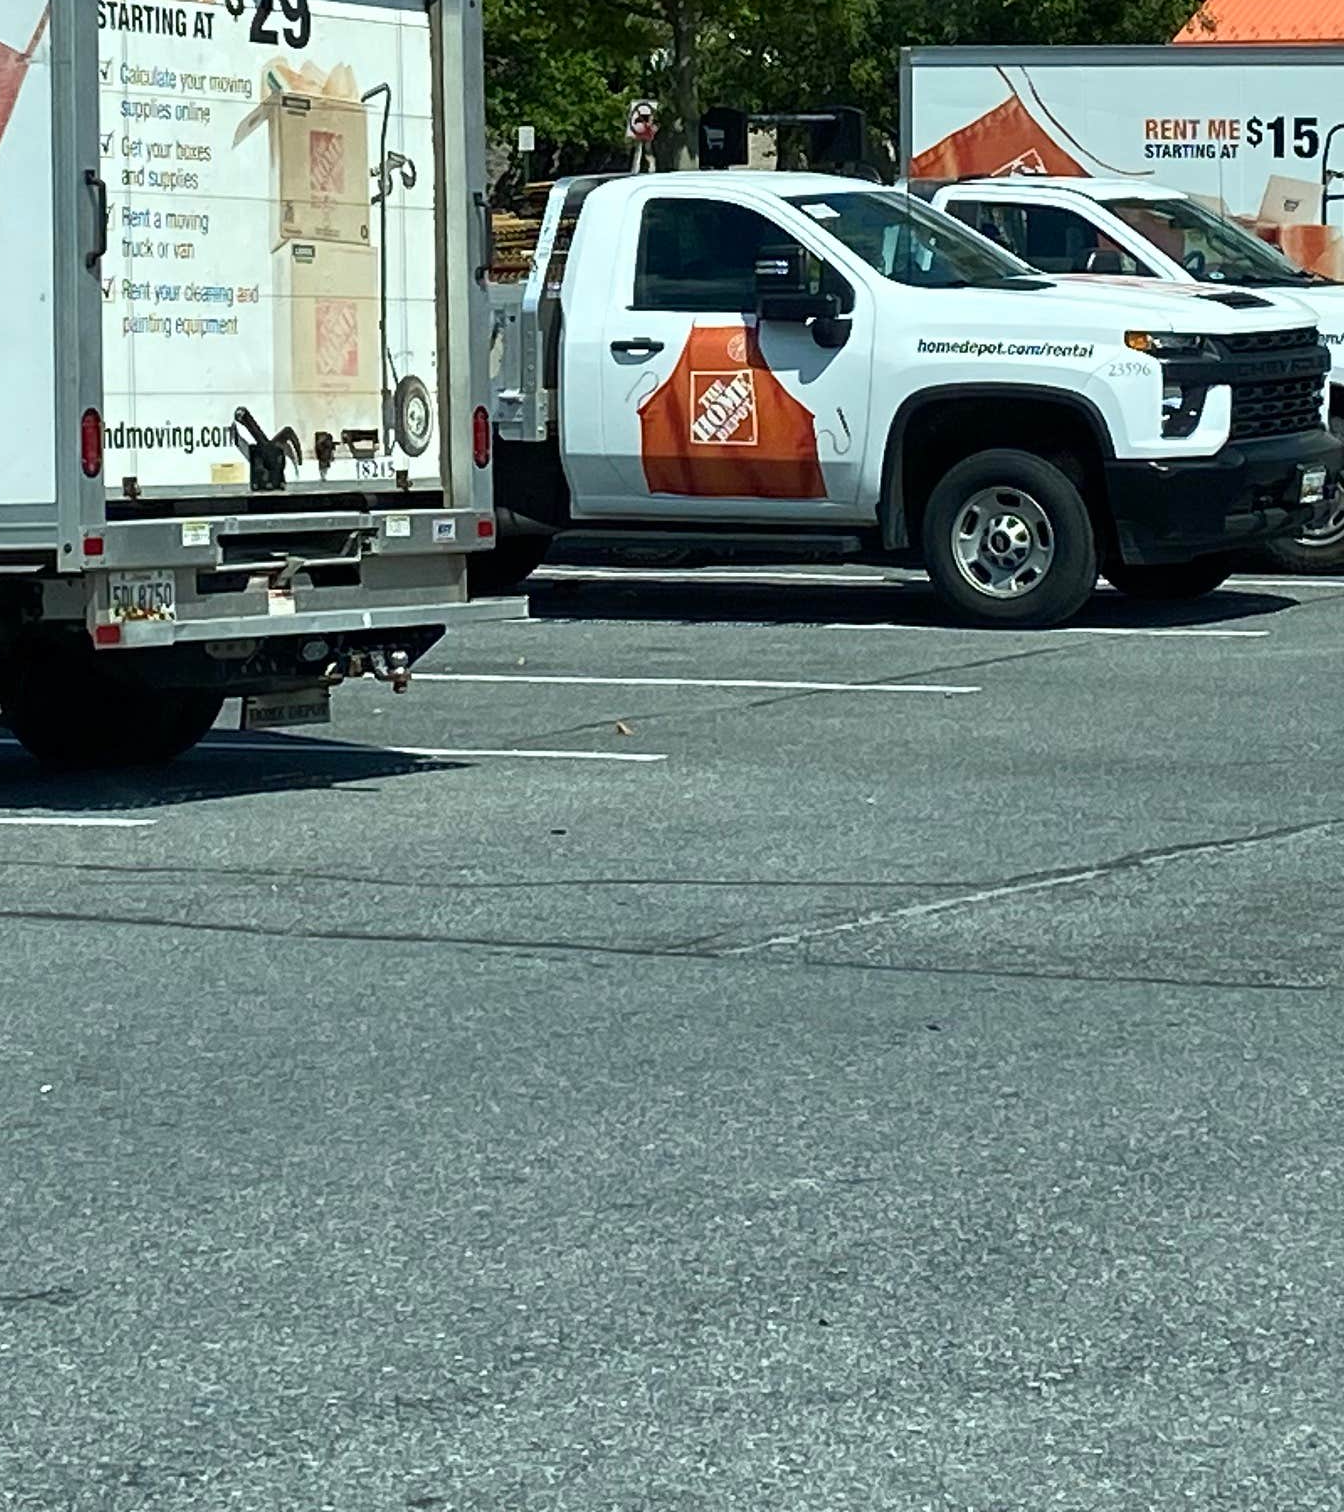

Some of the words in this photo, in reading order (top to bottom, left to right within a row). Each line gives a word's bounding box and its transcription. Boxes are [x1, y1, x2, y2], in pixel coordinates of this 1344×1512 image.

[97, 0, 187, 37] STARTING
[193, 11, 215, 39] AT
[120, 62, 177, 89] Calculate
[180, 73, 207, 93] your
[209, 75, 252, 99] moving
[120, 99, 172, 123] supplies
[176, 101, 211, 122] online
[1145, 119, 1200, 139] RENT
[1208, 119, 1240, 139] ME
[1246, 116, 1319, 159] $15
[121, 136, 143, 157] Get
[146, 141, 173, 162] your
[176, 140, 212, 161] boxes
[1144, 144, 1216, 159] STARTING
[1219, 144, 1239, 159] AT
[121, 167, 145, 186] and
[148, 168, 199, 191] supplies
[121, 207, 151, 229] Rent
[154, 213, 162, 229] a
[166, 212, 209, 236] moving
[121, 239, 154, 258] truck
[157, 243, 169, 258] or
[174, 243, 195, 259] van
[121, 278, 151, 301] Rent
[154, 284, 182, 306] your
[184, 282, 234, 307] cleaning
[236, 284, 260, 303] and
[122, 314, 172, 337] painting
[175, 316, 238, 338] equipment
[917, 339, 1095, 357] homedepot.com/rental
[1108, 363, 1152, 377] 23596
[692, 371, 753, 441] HOME
